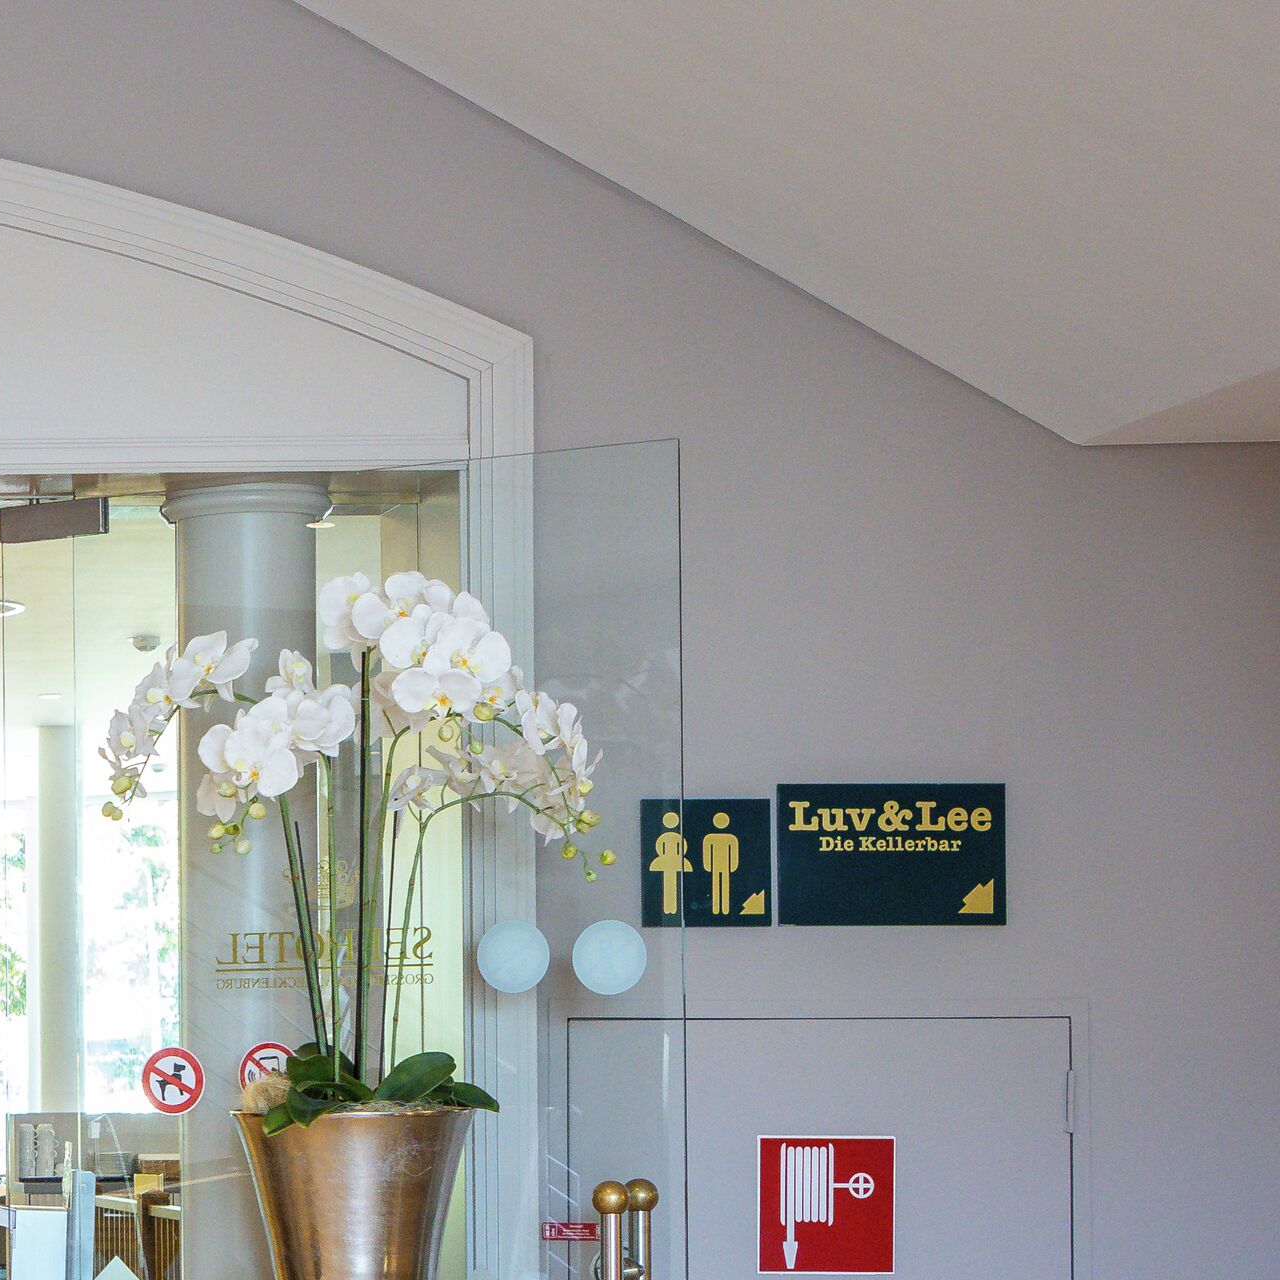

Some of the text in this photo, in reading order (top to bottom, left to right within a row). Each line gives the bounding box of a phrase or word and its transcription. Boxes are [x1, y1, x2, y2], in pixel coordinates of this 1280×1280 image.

[788, 800, 993, 832] Luv&Lee
[819, 836, 962, 852] Die Kellerbar
